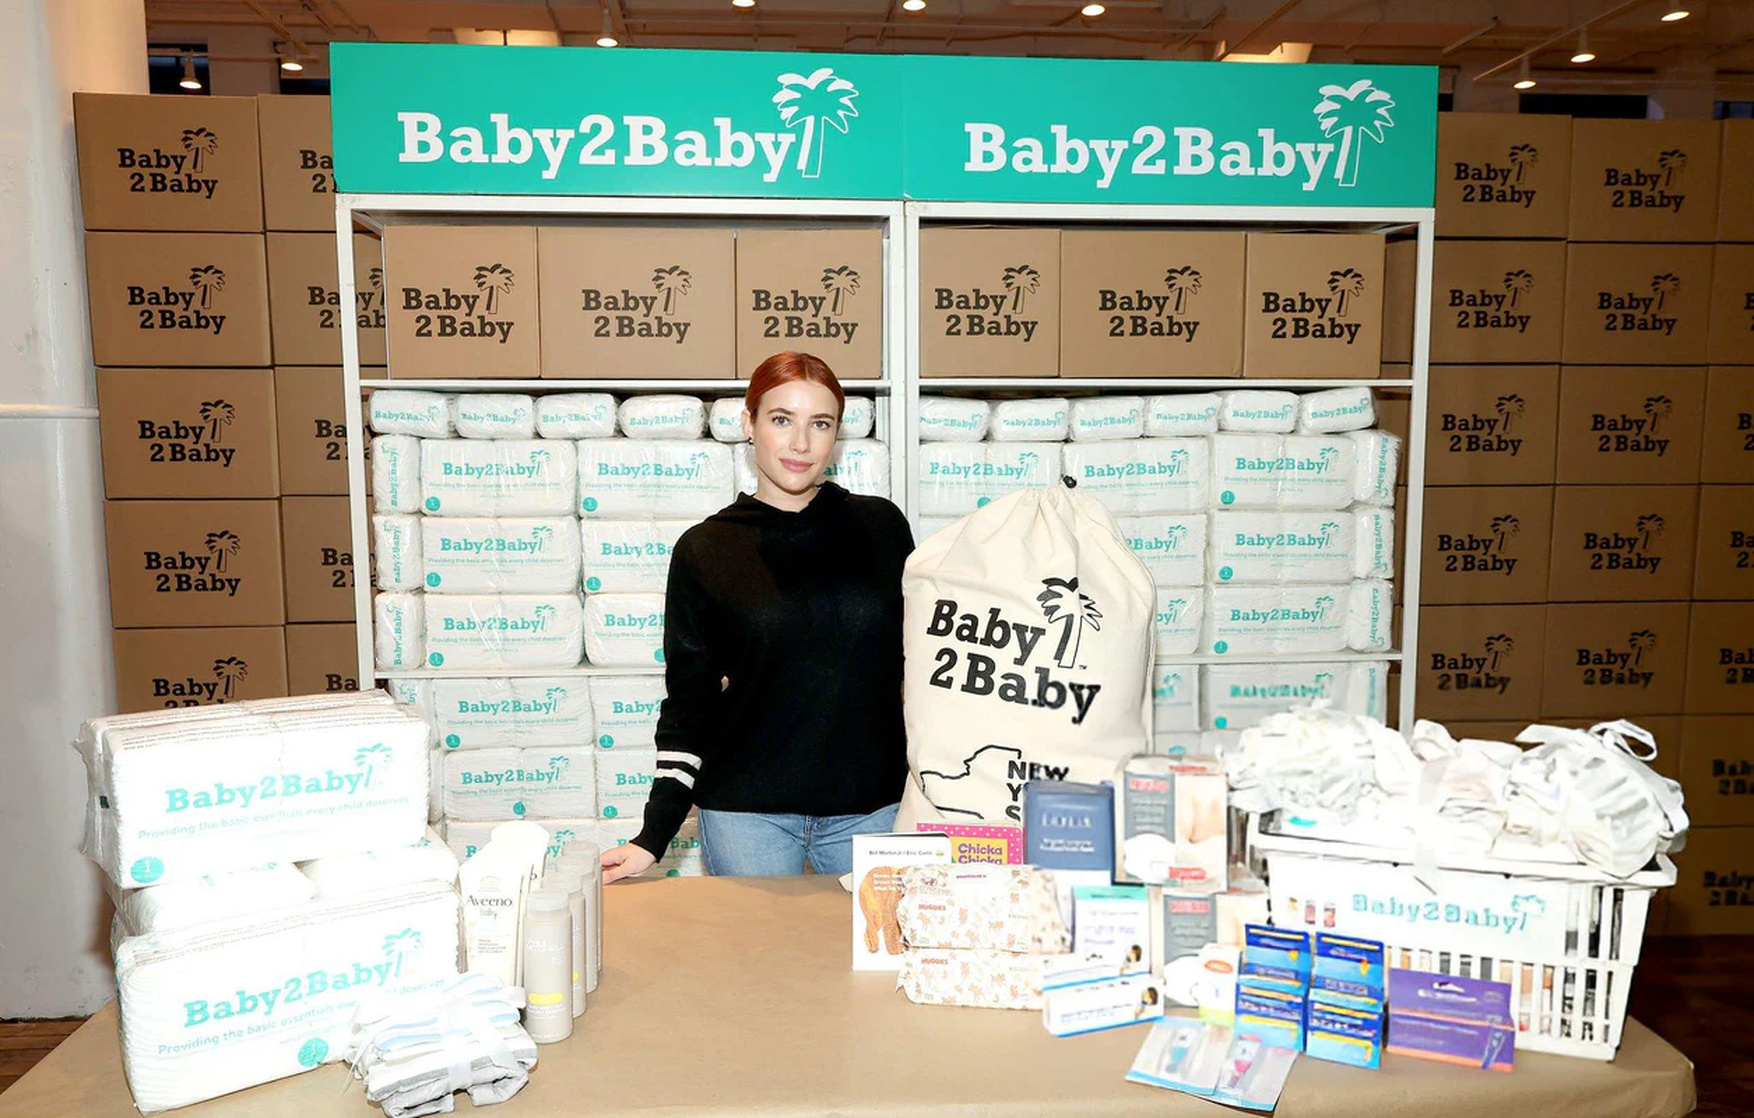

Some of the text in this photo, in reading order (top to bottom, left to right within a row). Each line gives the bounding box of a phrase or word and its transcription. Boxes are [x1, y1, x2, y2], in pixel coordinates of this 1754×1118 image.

[397, 111, 797, 182] Baby2Baby
[964, 122, 1334, 190] Baby2Baby
[117, 148, 187, 174] Baby
[300, 150, 333, 170] Ba
[1455, 163, 1512, 185] Baby
[1605, 168, 1661, 191] Baby
[128, 286, 195, 312] Baby
[308, 286, 374, 310] Bay
[402, 288, 479, 317] Baby
[582, 289, 657, 318] Baby
[752, 290, 825, 318] Baby
[935, 288, 1007, 316] Baby
[1099, 290, 1170, 316] Baby
[1262, 292, 1332, 318] Baby
[1449, 290, 1507, 312] Baby
[1597, 293, 1653, 315] Baby
[1233, 410, 1284, 419] Baby2Baby
[1312, 407, 1363, 419] Baby2Baby
[138, 420, 205, 444] Baby
[1442, 414, 1498, 436] Baby
[1591, 414, 1646, 436] Baby
[1084, 462, 1176, 479] Baby2Baby
[1236, 458, 1325, 474] Baby2Baby
[440, 537, 537, 554] Baby2Baby
[601, 542, 673, 557] Baby2Ba
[1235, 533, 1326, 549] Baby2Baby
[1438, 535, 1493, 557] Baby
[1584, 532, 1638, 554] Baby
[144, 552, 211, 575] Baby
[1230, 609, 1320, 624] Baby2Baby
[926, 599, 1046, 666] Baby
[1431, 653, 1487, 675] Baby
[1576, 649, 1631, 671] Baby
[153, 679, 219, 701] Baby
[929, 647, 1102, 725] 2Baby
[458, 700, 552, 715] Baby2Baby
[612, 701, 662, 716] Baby2
[461, 769, 555, 785] Baby2Baby
[1008, 760, 1069, 780] NEW
[165, 768, 366, 812] Baby2Baby
[138, 824, 195, 839] Providing
[199, 821, 218, 830] the
[221, 817, 249, 827] basic
[306, 805, 335, 816] every
[338, 801, 363, 811] child
[958, 842, 1003, 857] Chicka
[467, 895, 513, 907] Aveeno
[918, 903, 946, 911] HUGGIES
[183, 959, 396, 1028] Baby2Baby
[159, 1037, 219, 1055] Providing
[223, 1030, 244, 1041] the
[247, 1020, 277, 1035] basic
[280, 1006, 334, 1027] essentials
